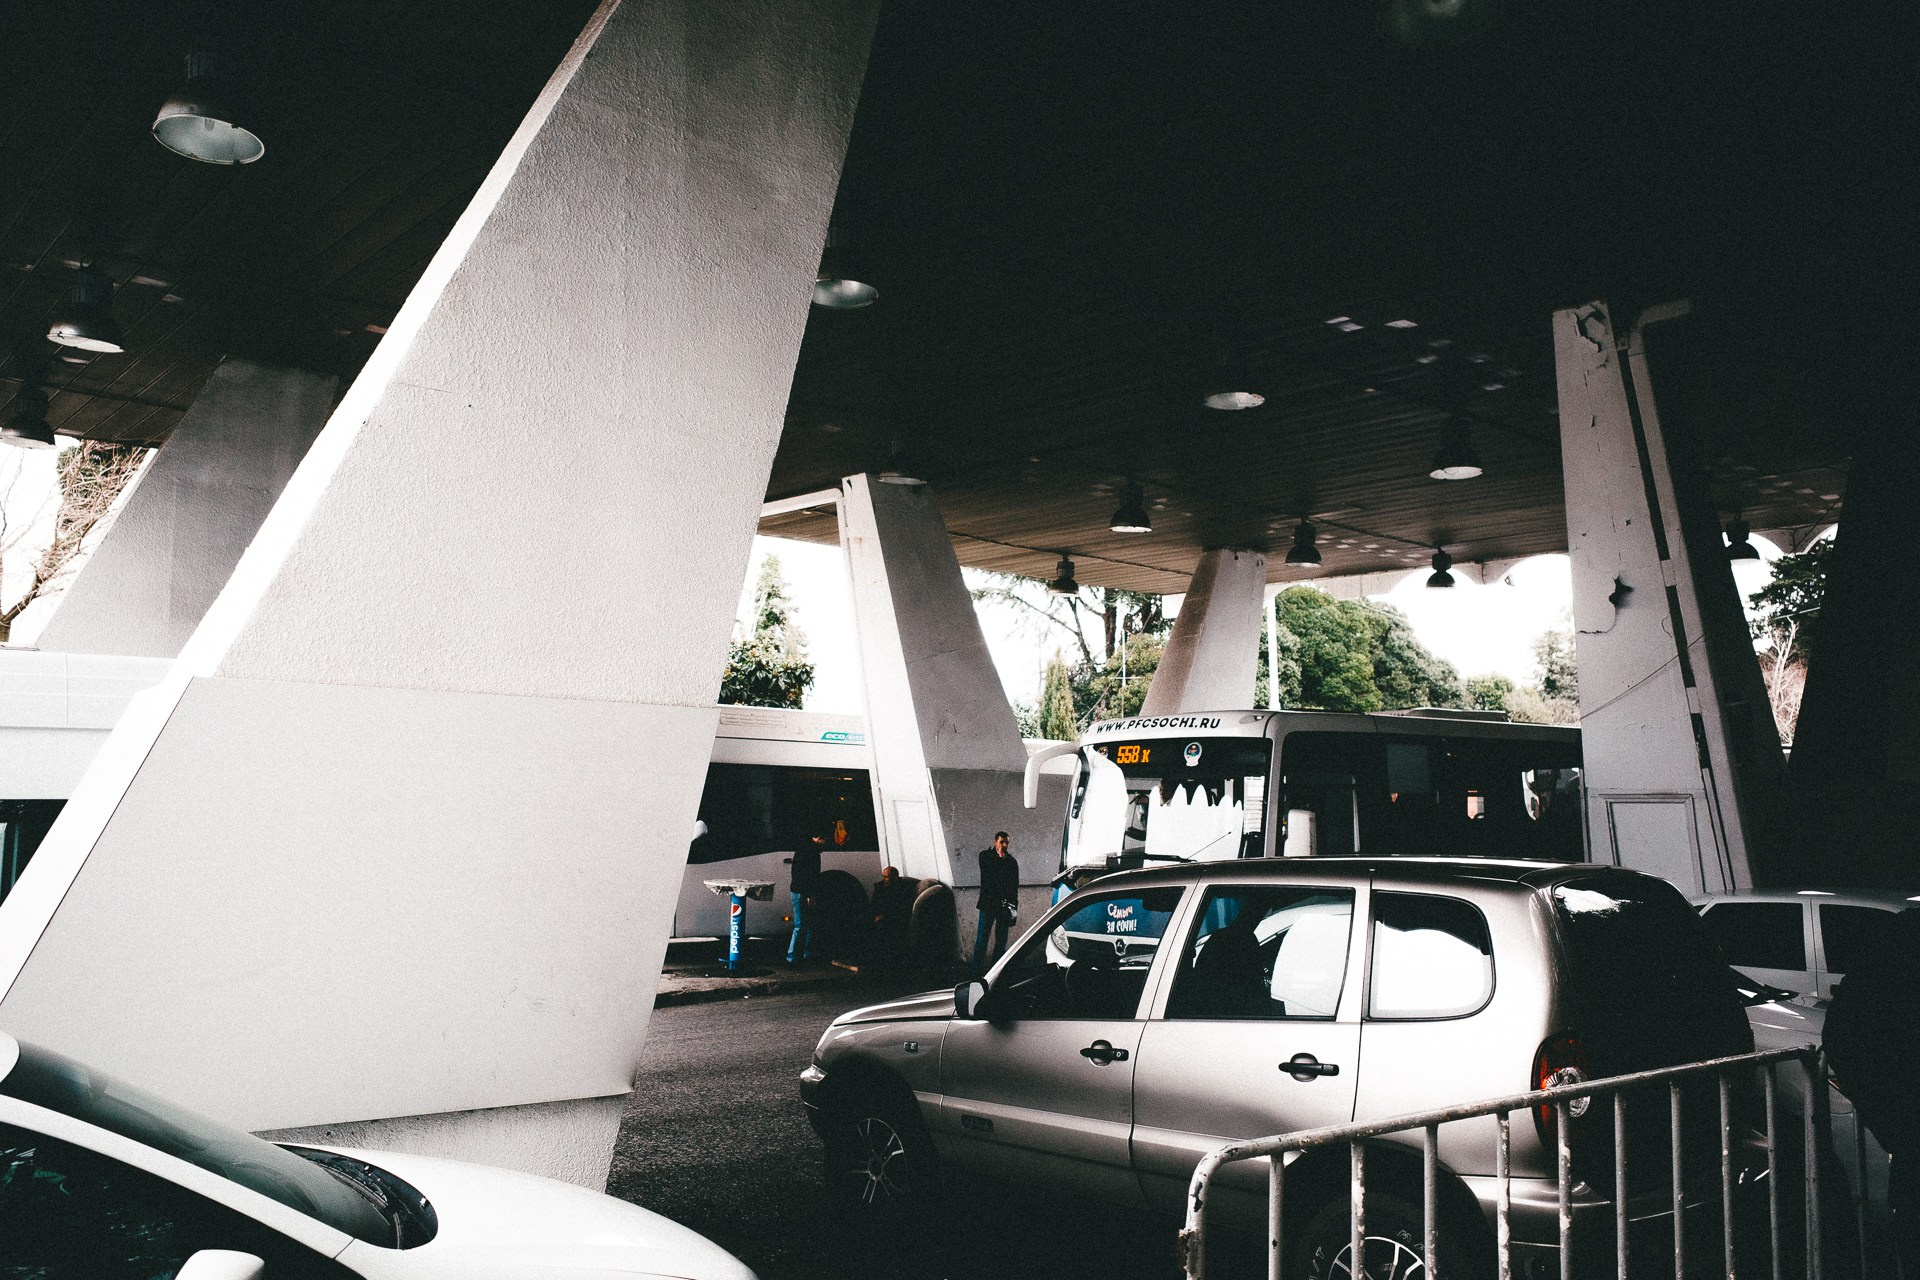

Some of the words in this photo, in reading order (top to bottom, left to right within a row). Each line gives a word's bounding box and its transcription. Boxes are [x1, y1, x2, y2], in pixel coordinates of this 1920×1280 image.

[1097, 717, 1221, 733] WWW.PFCSOCHI.RU
[1116, 745, 1141, 764] 558
[730, 917, 740, 953] pepsi
